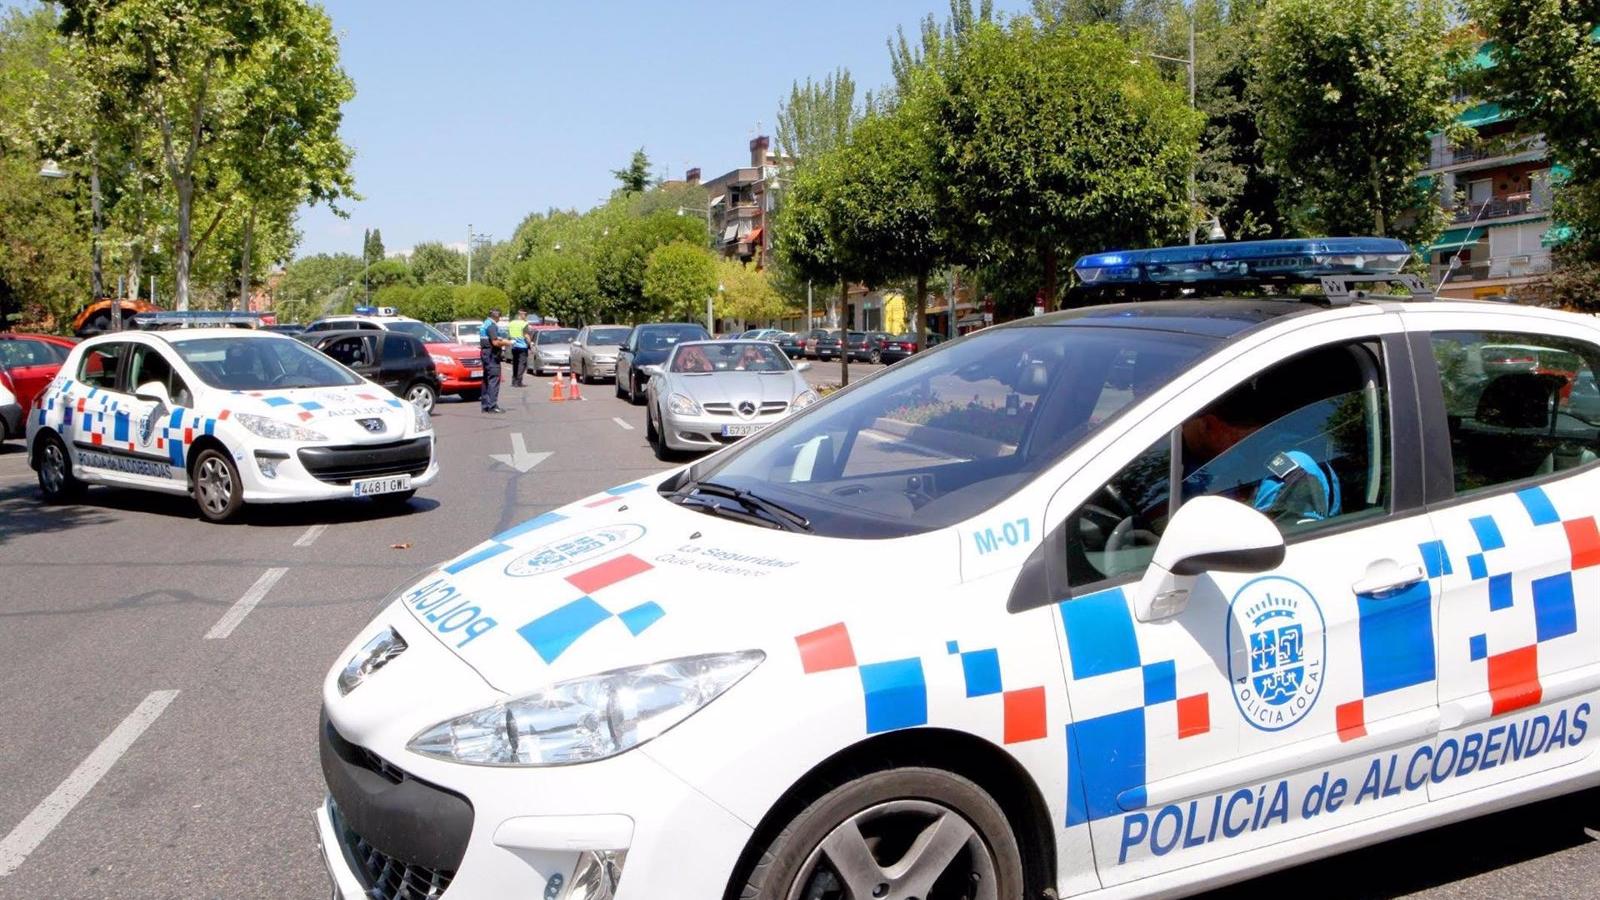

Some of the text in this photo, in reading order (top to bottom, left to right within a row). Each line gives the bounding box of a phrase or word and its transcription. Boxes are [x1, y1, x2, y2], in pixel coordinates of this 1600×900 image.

[361, 478, 408, 494] 4481 GWL
[974, 517, 1031, 555] M-07
[701, 547, 800, 568] Seguridad
[1237, 659, 1319, 723] POLICIA LOCAL
[1301, 771, 1348, 820] de
[1354, 702, 1591, 806] ALCOBENDAS
